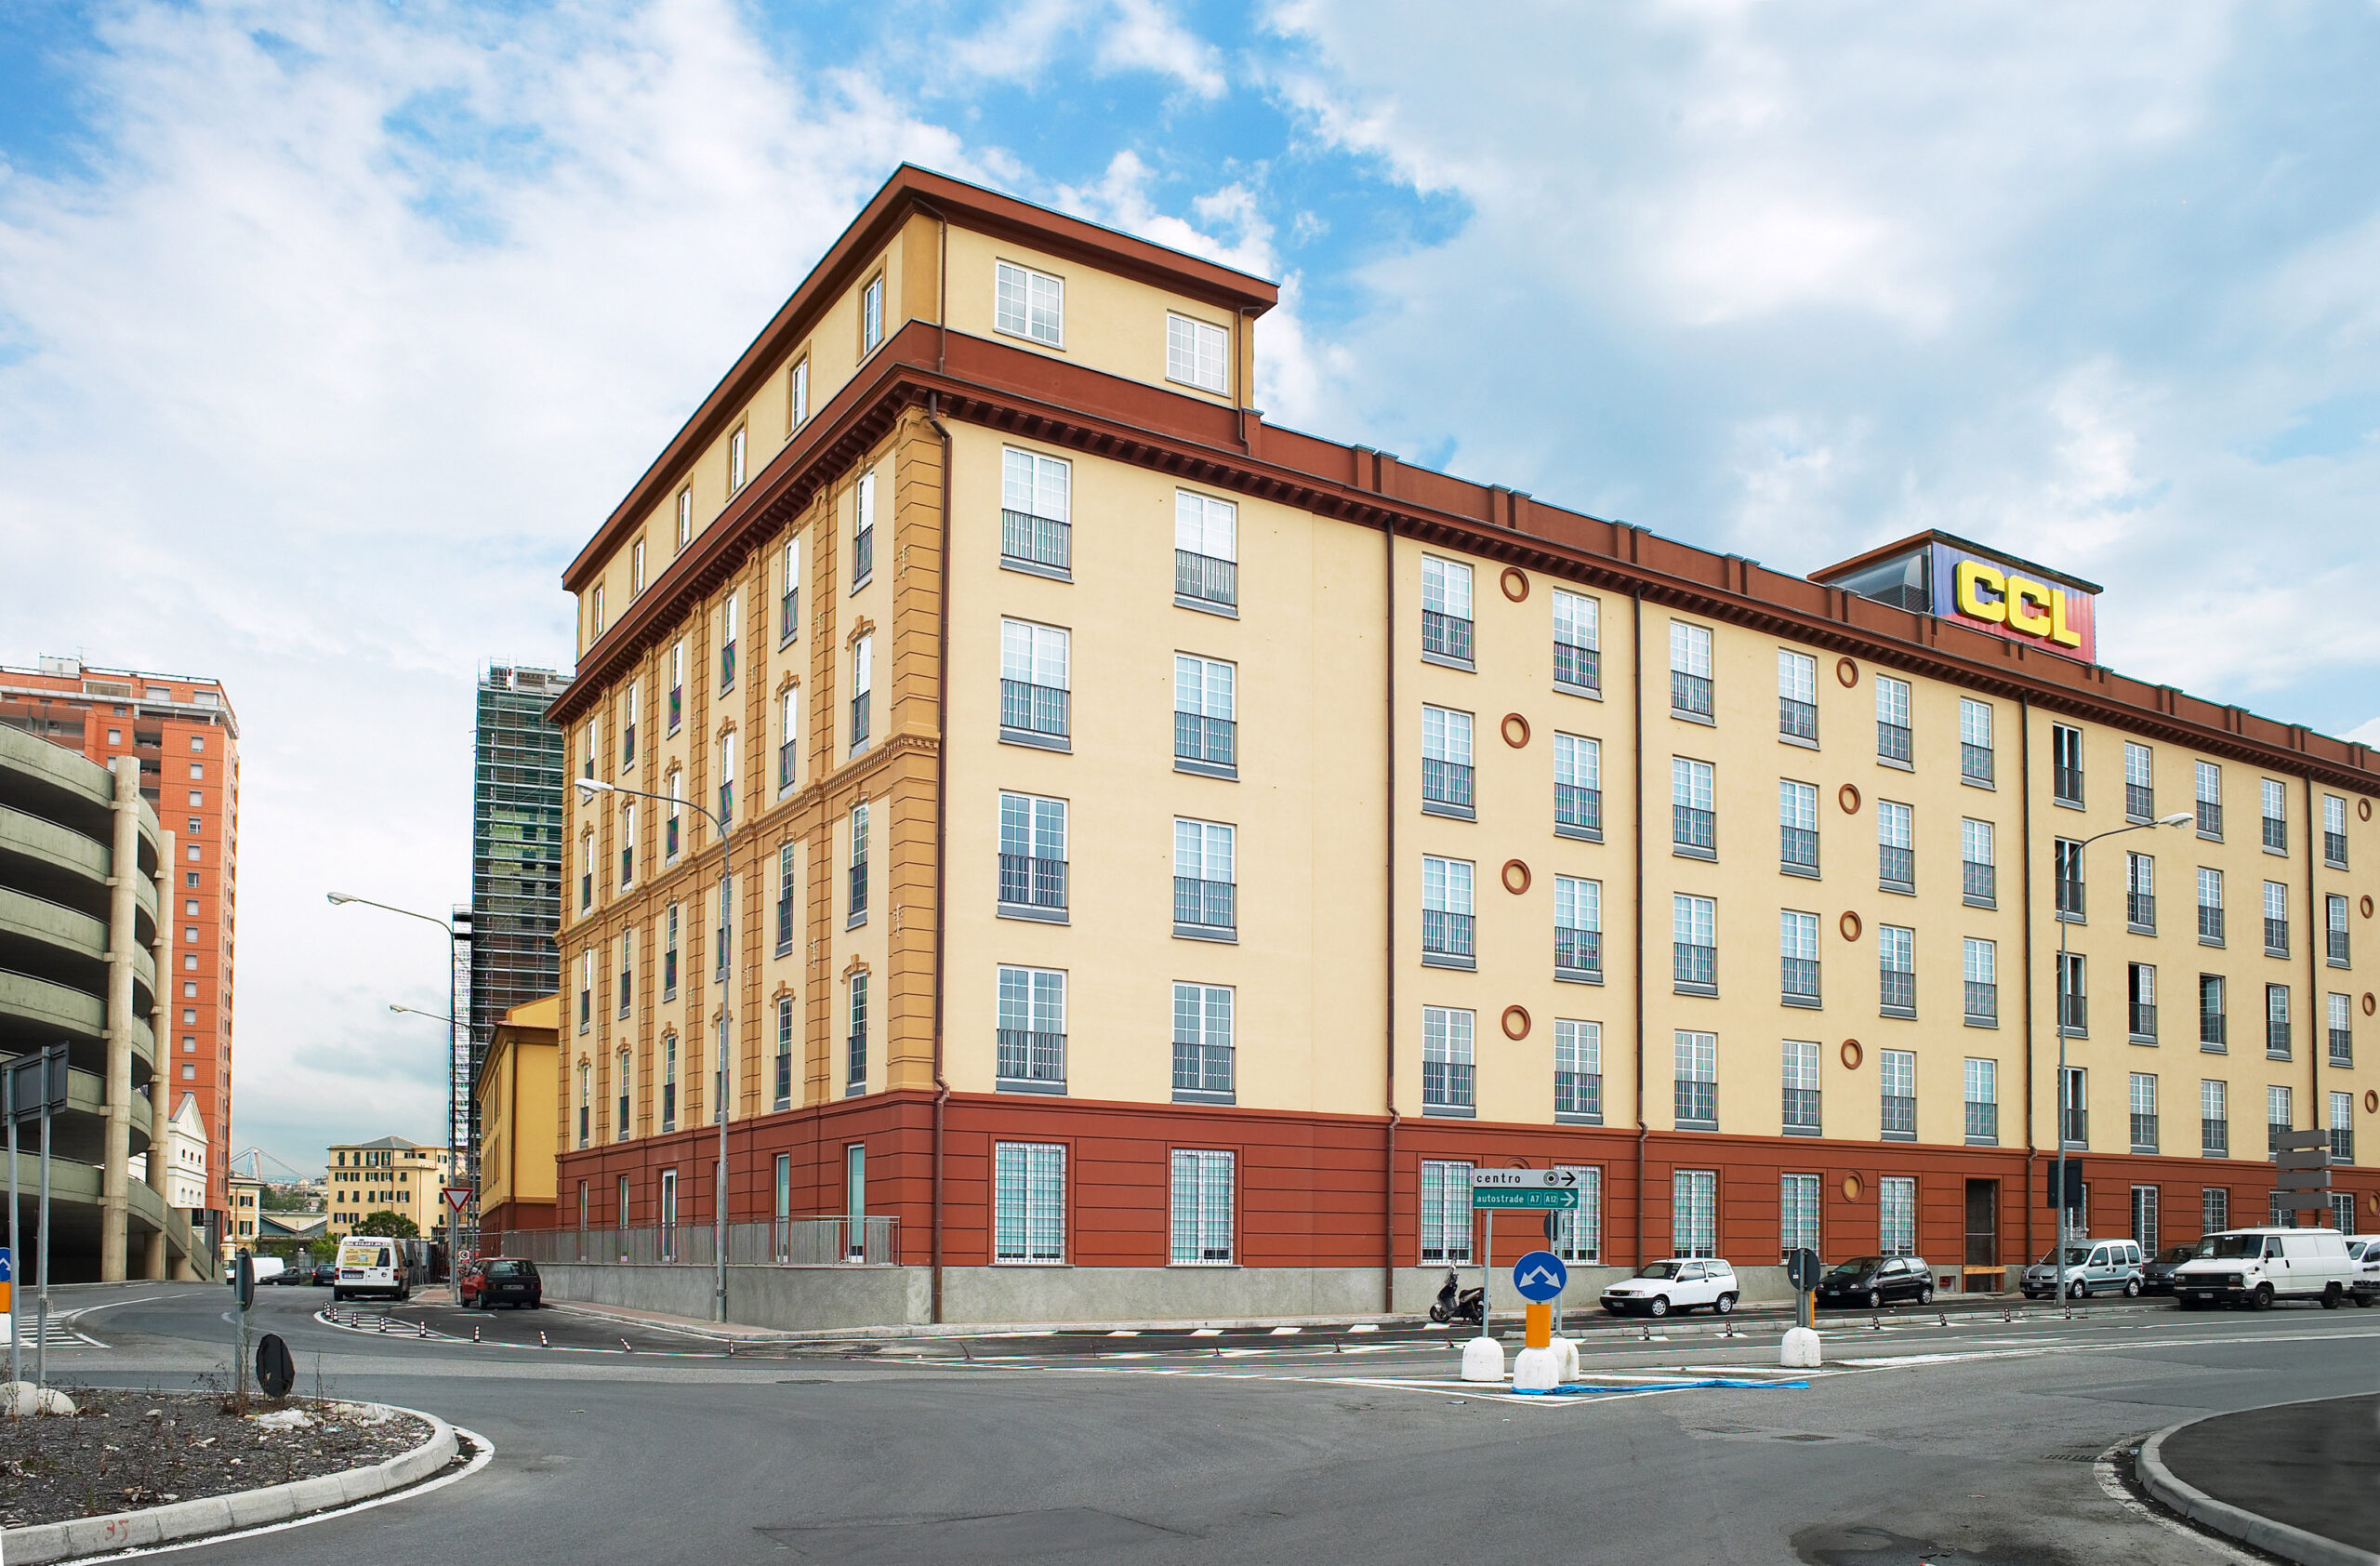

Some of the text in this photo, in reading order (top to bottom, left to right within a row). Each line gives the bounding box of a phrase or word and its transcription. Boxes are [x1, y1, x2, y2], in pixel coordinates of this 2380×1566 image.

[1957, 559, 2081, 649] CCL
[1476, 1173, 1521, 1183] centro
[1476, 1194, 1557, 1203] autostrade A7 A12
